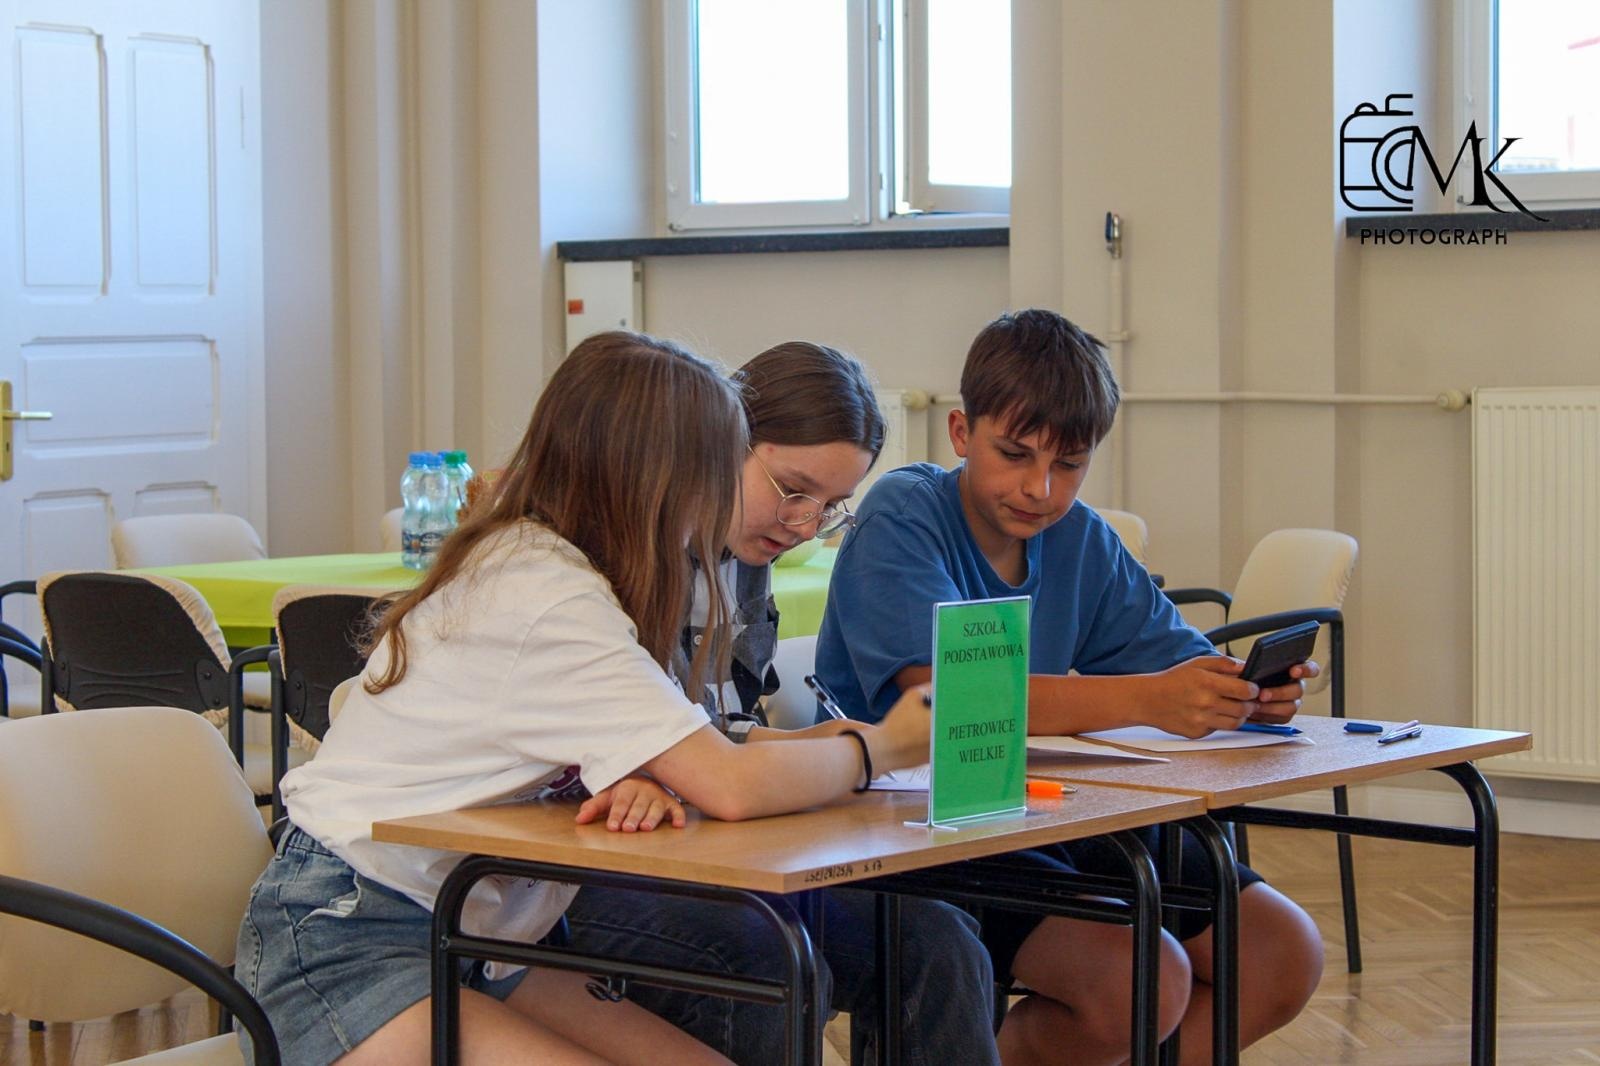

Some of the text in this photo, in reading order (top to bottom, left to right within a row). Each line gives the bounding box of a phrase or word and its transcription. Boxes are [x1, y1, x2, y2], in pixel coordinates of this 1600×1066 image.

[944, 643, 1025, 665] PODSTAWOWA
[948, 718, 1017, 741] PIETROWICE
[959, 744, 1006, 764] WIELKIE
